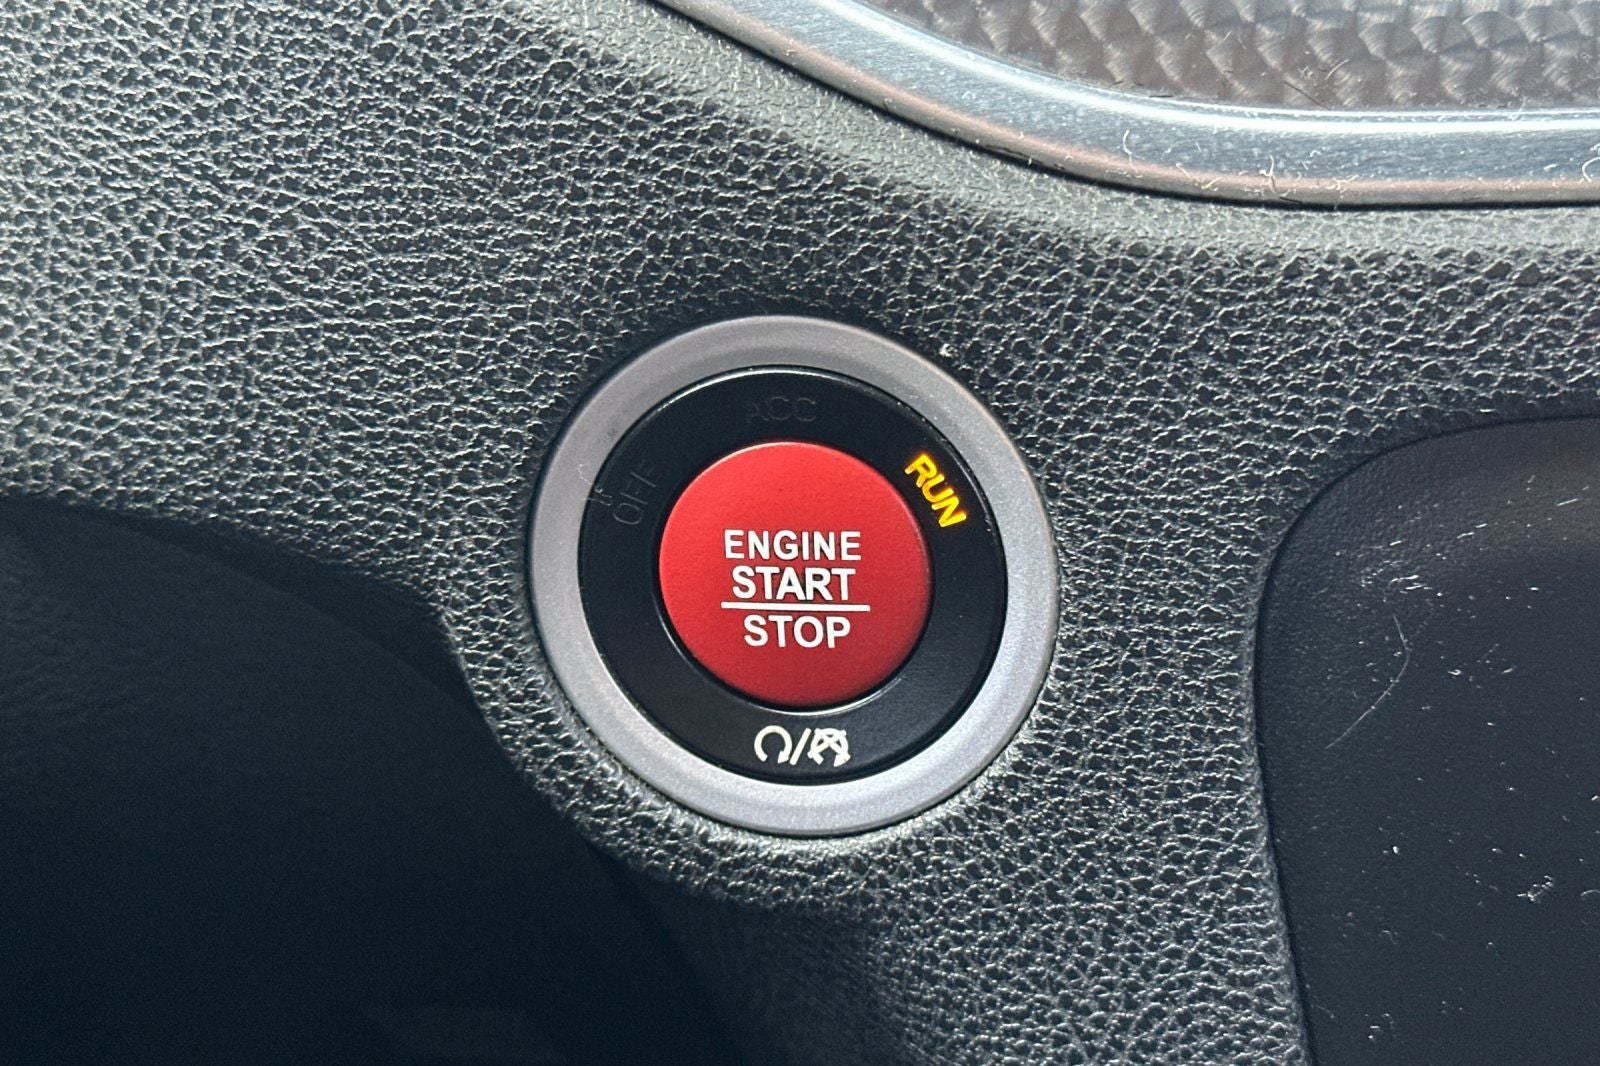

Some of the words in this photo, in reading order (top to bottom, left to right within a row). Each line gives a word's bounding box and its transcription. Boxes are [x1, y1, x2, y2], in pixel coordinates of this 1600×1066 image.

[745, 395, 817, 424] ACC
[904, 453, 967, 527] RUN
[724, 529, 862, 562] ENGINE
[732, 565, 855, 601] START
[743, 614, 851, 649] STOP
